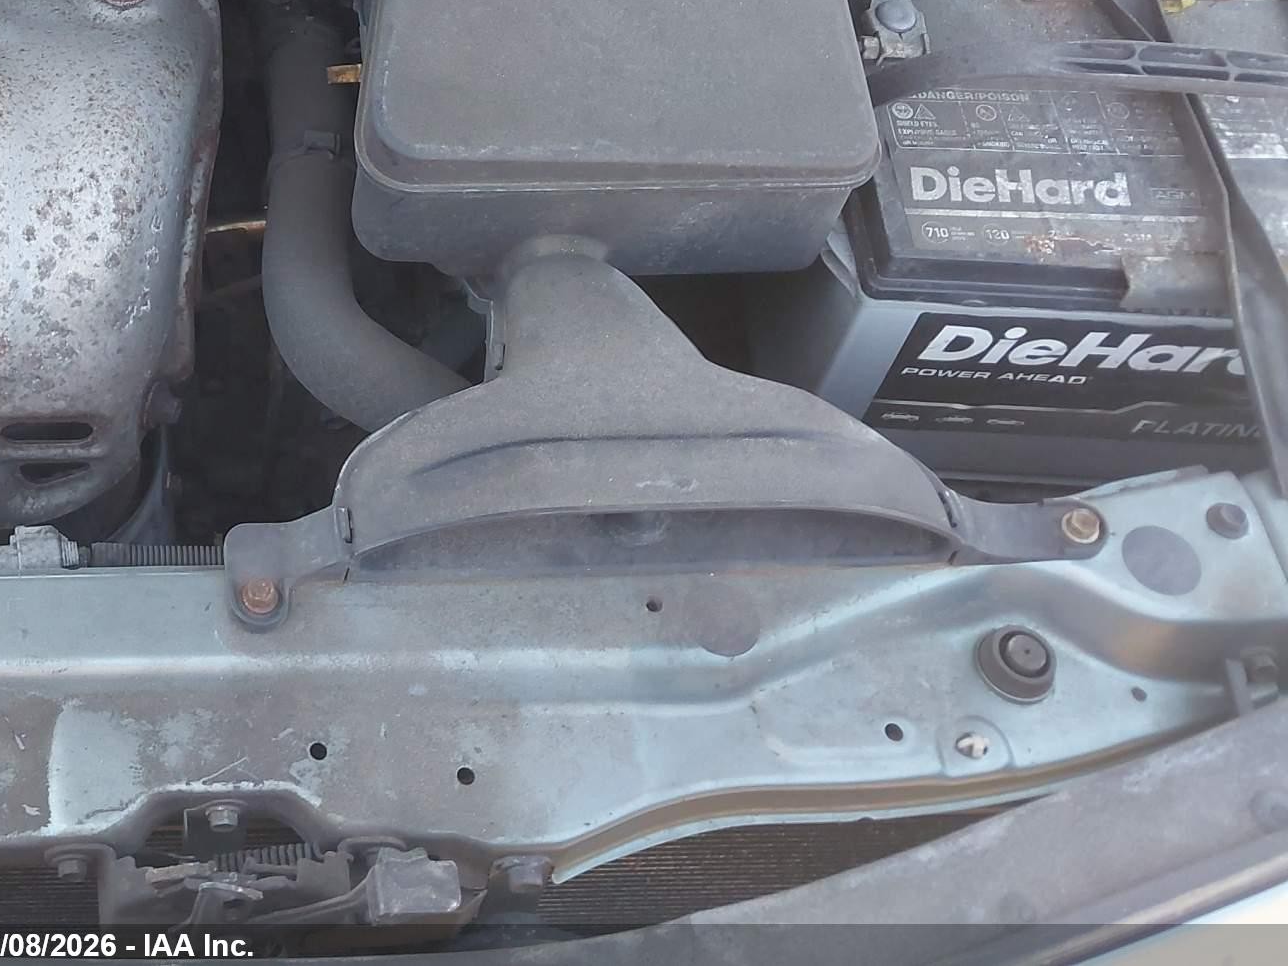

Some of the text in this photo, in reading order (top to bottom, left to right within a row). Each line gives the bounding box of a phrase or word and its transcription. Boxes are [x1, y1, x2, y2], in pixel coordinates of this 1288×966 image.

[909, 164, 1133, 208] DieHard
[925, 227, 950, 239] 710
[900, 366, 1087, 385] POWER AHEAD
[1131, 418, 1264, 438] PLATIN
